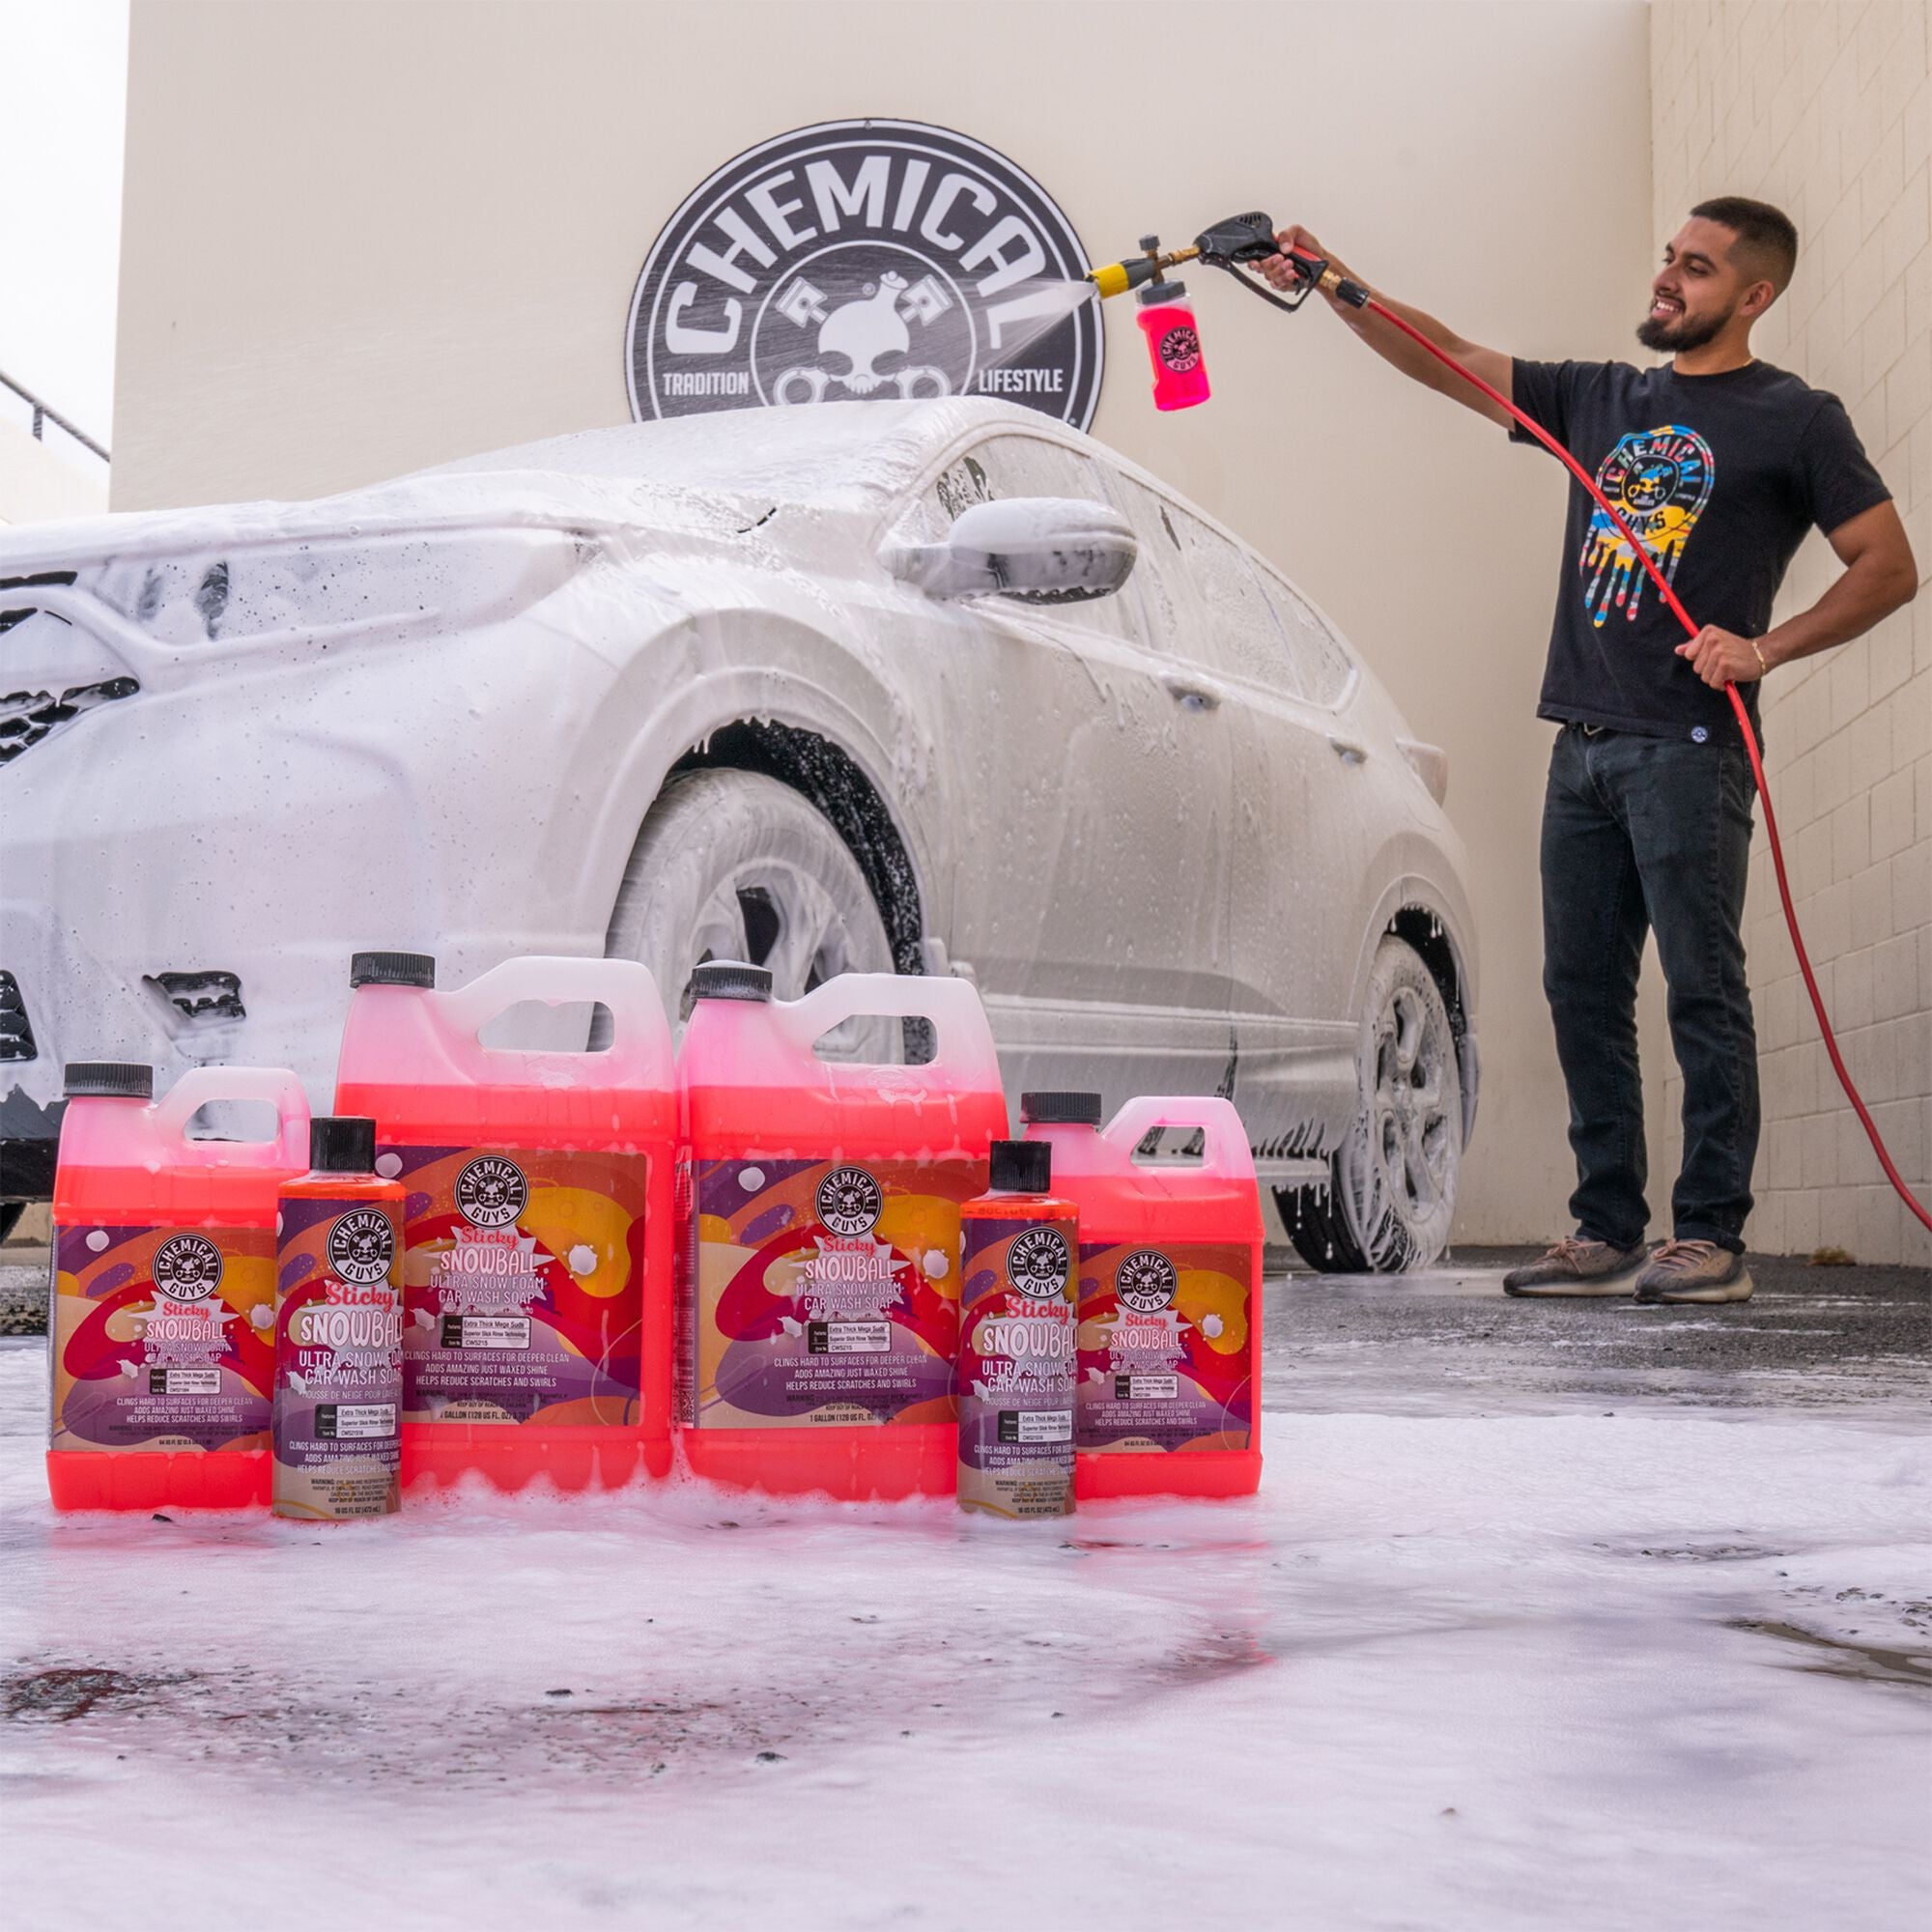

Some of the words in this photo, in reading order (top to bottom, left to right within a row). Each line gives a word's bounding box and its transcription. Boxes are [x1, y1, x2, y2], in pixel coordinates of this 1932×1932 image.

[666, 156, 1065, 354] CHEMICAL
[1174, 356, 1197, 369] GUYS
[663, 372, 749, 395] TRADITION
[979, 368, 1063, 392] LIFESTYLE
[461, 1158, 522, 1193] CHEMICAL
[821, 1172, 876, 1203] CHEMICAL
[471, 1208, 510, 1223] GUYS
[334, 1214, 391, 1249] CHEMICAL
[832, 1216, 867, 1232] GUYS
[461, 1226, 518, 1249] Sticky
[157, 1239, 218, 1269] CHEMICAL
[823, 1236, 875, 1256] Sticky
[1013, 1234, 1066, 1264] CHEMICAL
[440, 1249, 538, 1275] SNOWBALL
[805, 1257, 895, 1282] SNOWBALL
[1122, 1255, 1172, 1284] CHEMICAL
[345, 1263, 383, 1279] GUYS
[168, 1282, 207, 1297] GUYS
[431, 1276, 468, 1288] ULTRA
[472, 1277, 510, 1289] SNOW
[513, 1277, 544, 1291] FOAM
[797, 1283, 831, 1295] ULTRA
[836, 1283, 867, 1294] SNOW
[872, 1282, 901, 1294] FOAM
[1024, 1278, 1059, 1293] GUYS
[326, 1283, 392, 1311] Sticky
[439, 1290, 462, 1302] CAR
[467, 1291, 499, 1303] WASH
[504, 1292, 535, 1304] SOAP
[805, 1297, 827, 1310] CAR
[831, 1297, 861, 1309] WASH
[866, 1297, 894, 1309] SOAP
[1130, 1294, 1163, 1309] GUYS
[163, 1302, 210, 1320] Sticky
[1006, 1296, 1068, 1324] Sticky
[1125, 1314, 1167, 1328] Sticky
[147, 1318, 226, 1341] SNOWBALL
[1112, 1329, 1182, 1349] SNOWBALL
[299, 1351, 340, 1367] ULTRA
[346, 1351, 382, 1367] SNOW
[775, 1358, 798, 1367] CLINGS
[821, 1357, 829, 1366] TO
[831, 1357, 865, 1366] SURFACES
[880, 1355, 905, 1364] DEEPER
[426, 1364, 444, 1373] ADDS
[446, 1364, 479, 1373] AMAZING
[482, 1365, 497, 1374] JUST
[499, 1365, 526, 1375] WAXED
[527, 1366, 548, 1375] SHINE
[814, 1369, 845, 1378] AMAZING
[864, 1368, 888, 1377] WAXED
[982, 1360, 1022, 1376] ULTRA
[1026, 1362, 1060, 1376] SNOW
[305, 1370, 331, 1384] CAR
[337, 1370, 375, 1384] WASH
[416, 1376, 439, 1384] HELPS
[440, 1377, 469, 1385] REDUCE
[470, 1377, 511, 1386] SCRATCHES
[514, 1378, 527, 1386] AND
[529, 1378, 556, 1387] SWIRLS
[786, 1381, 808, 1390] HELPS
[810, 1381, 836, 1390] REDUCE
[838, 1380, 875, 1389] SCRATCHES
[988, 1378, 1013, 1392] CAR
[1019, 1378, 1054, 1392] WASH
